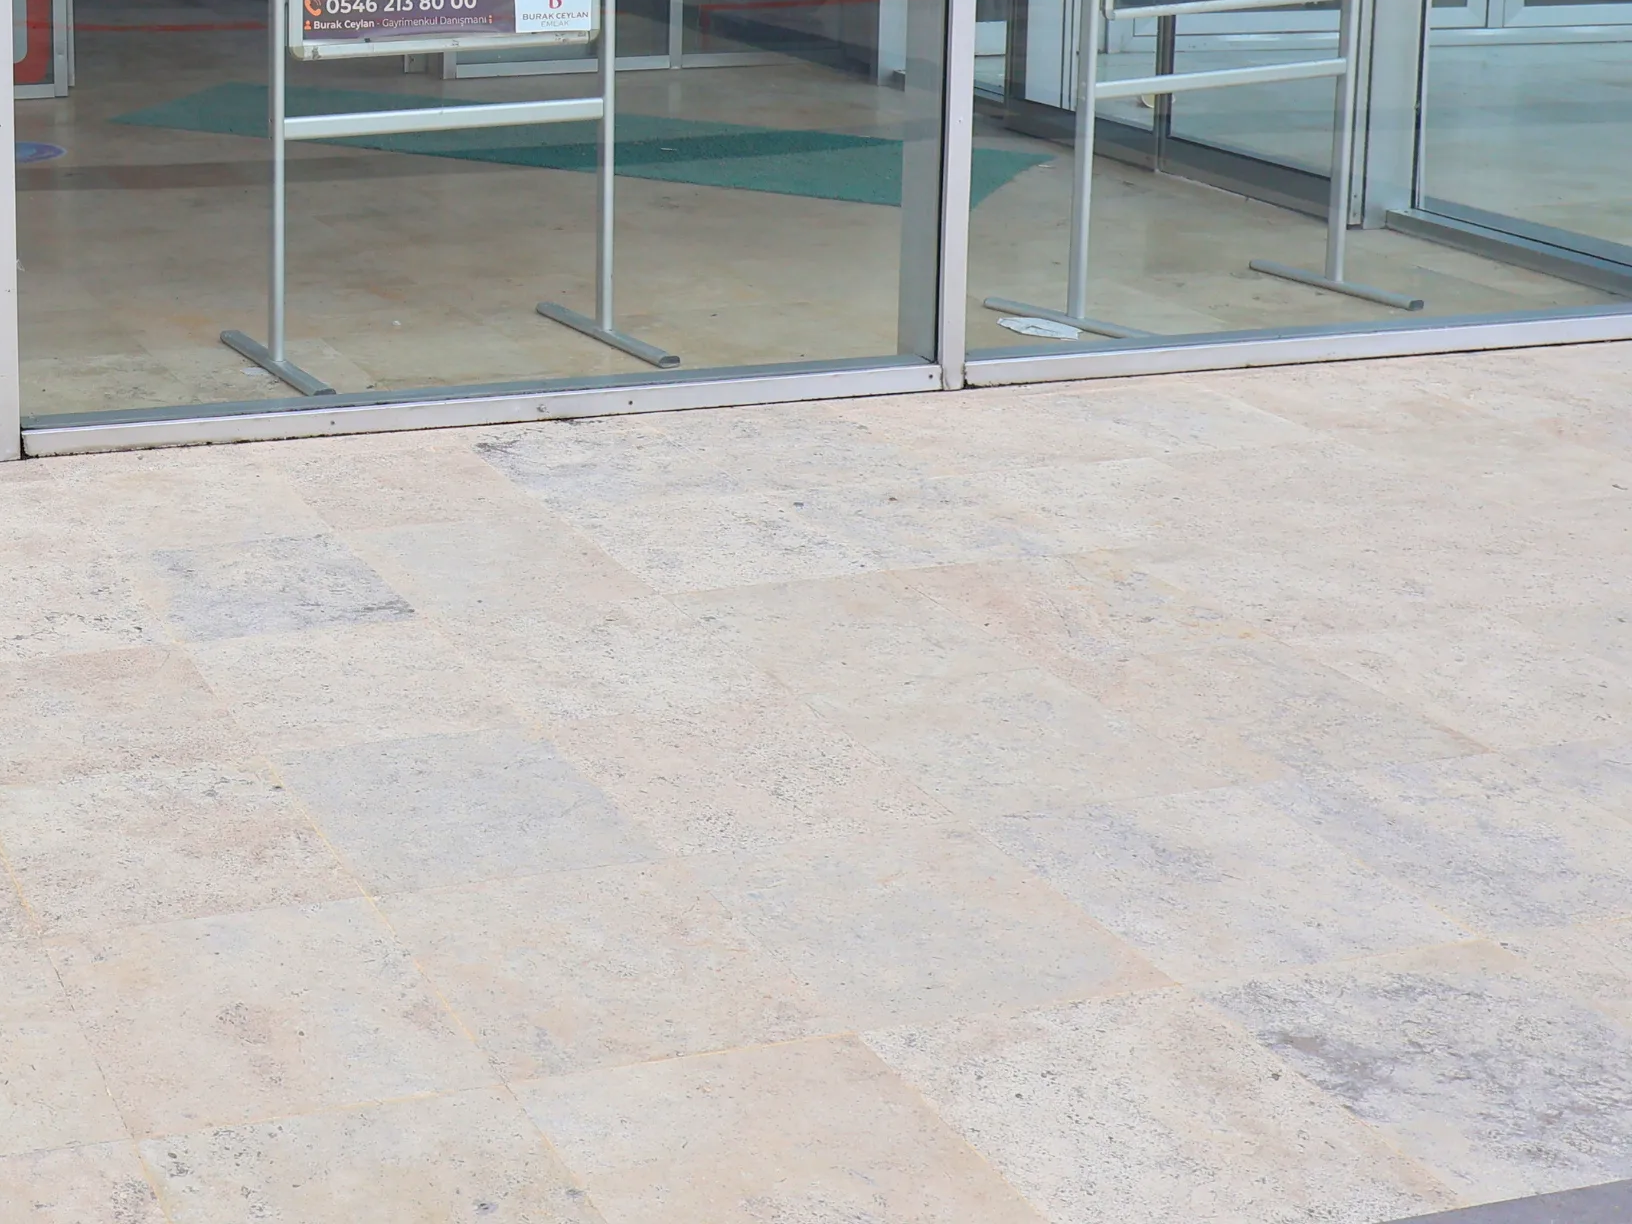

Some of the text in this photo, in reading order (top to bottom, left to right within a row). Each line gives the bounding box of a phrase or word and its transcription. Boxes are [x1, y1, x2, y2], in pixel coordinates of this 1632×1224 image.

[522, 11, 589, 21] BURAK CEYLAN
[313, 14, 487, 31] Burak Ceylan Gayrimenkul Danışmanı
[540, 19, 570, 28] EMLAK
